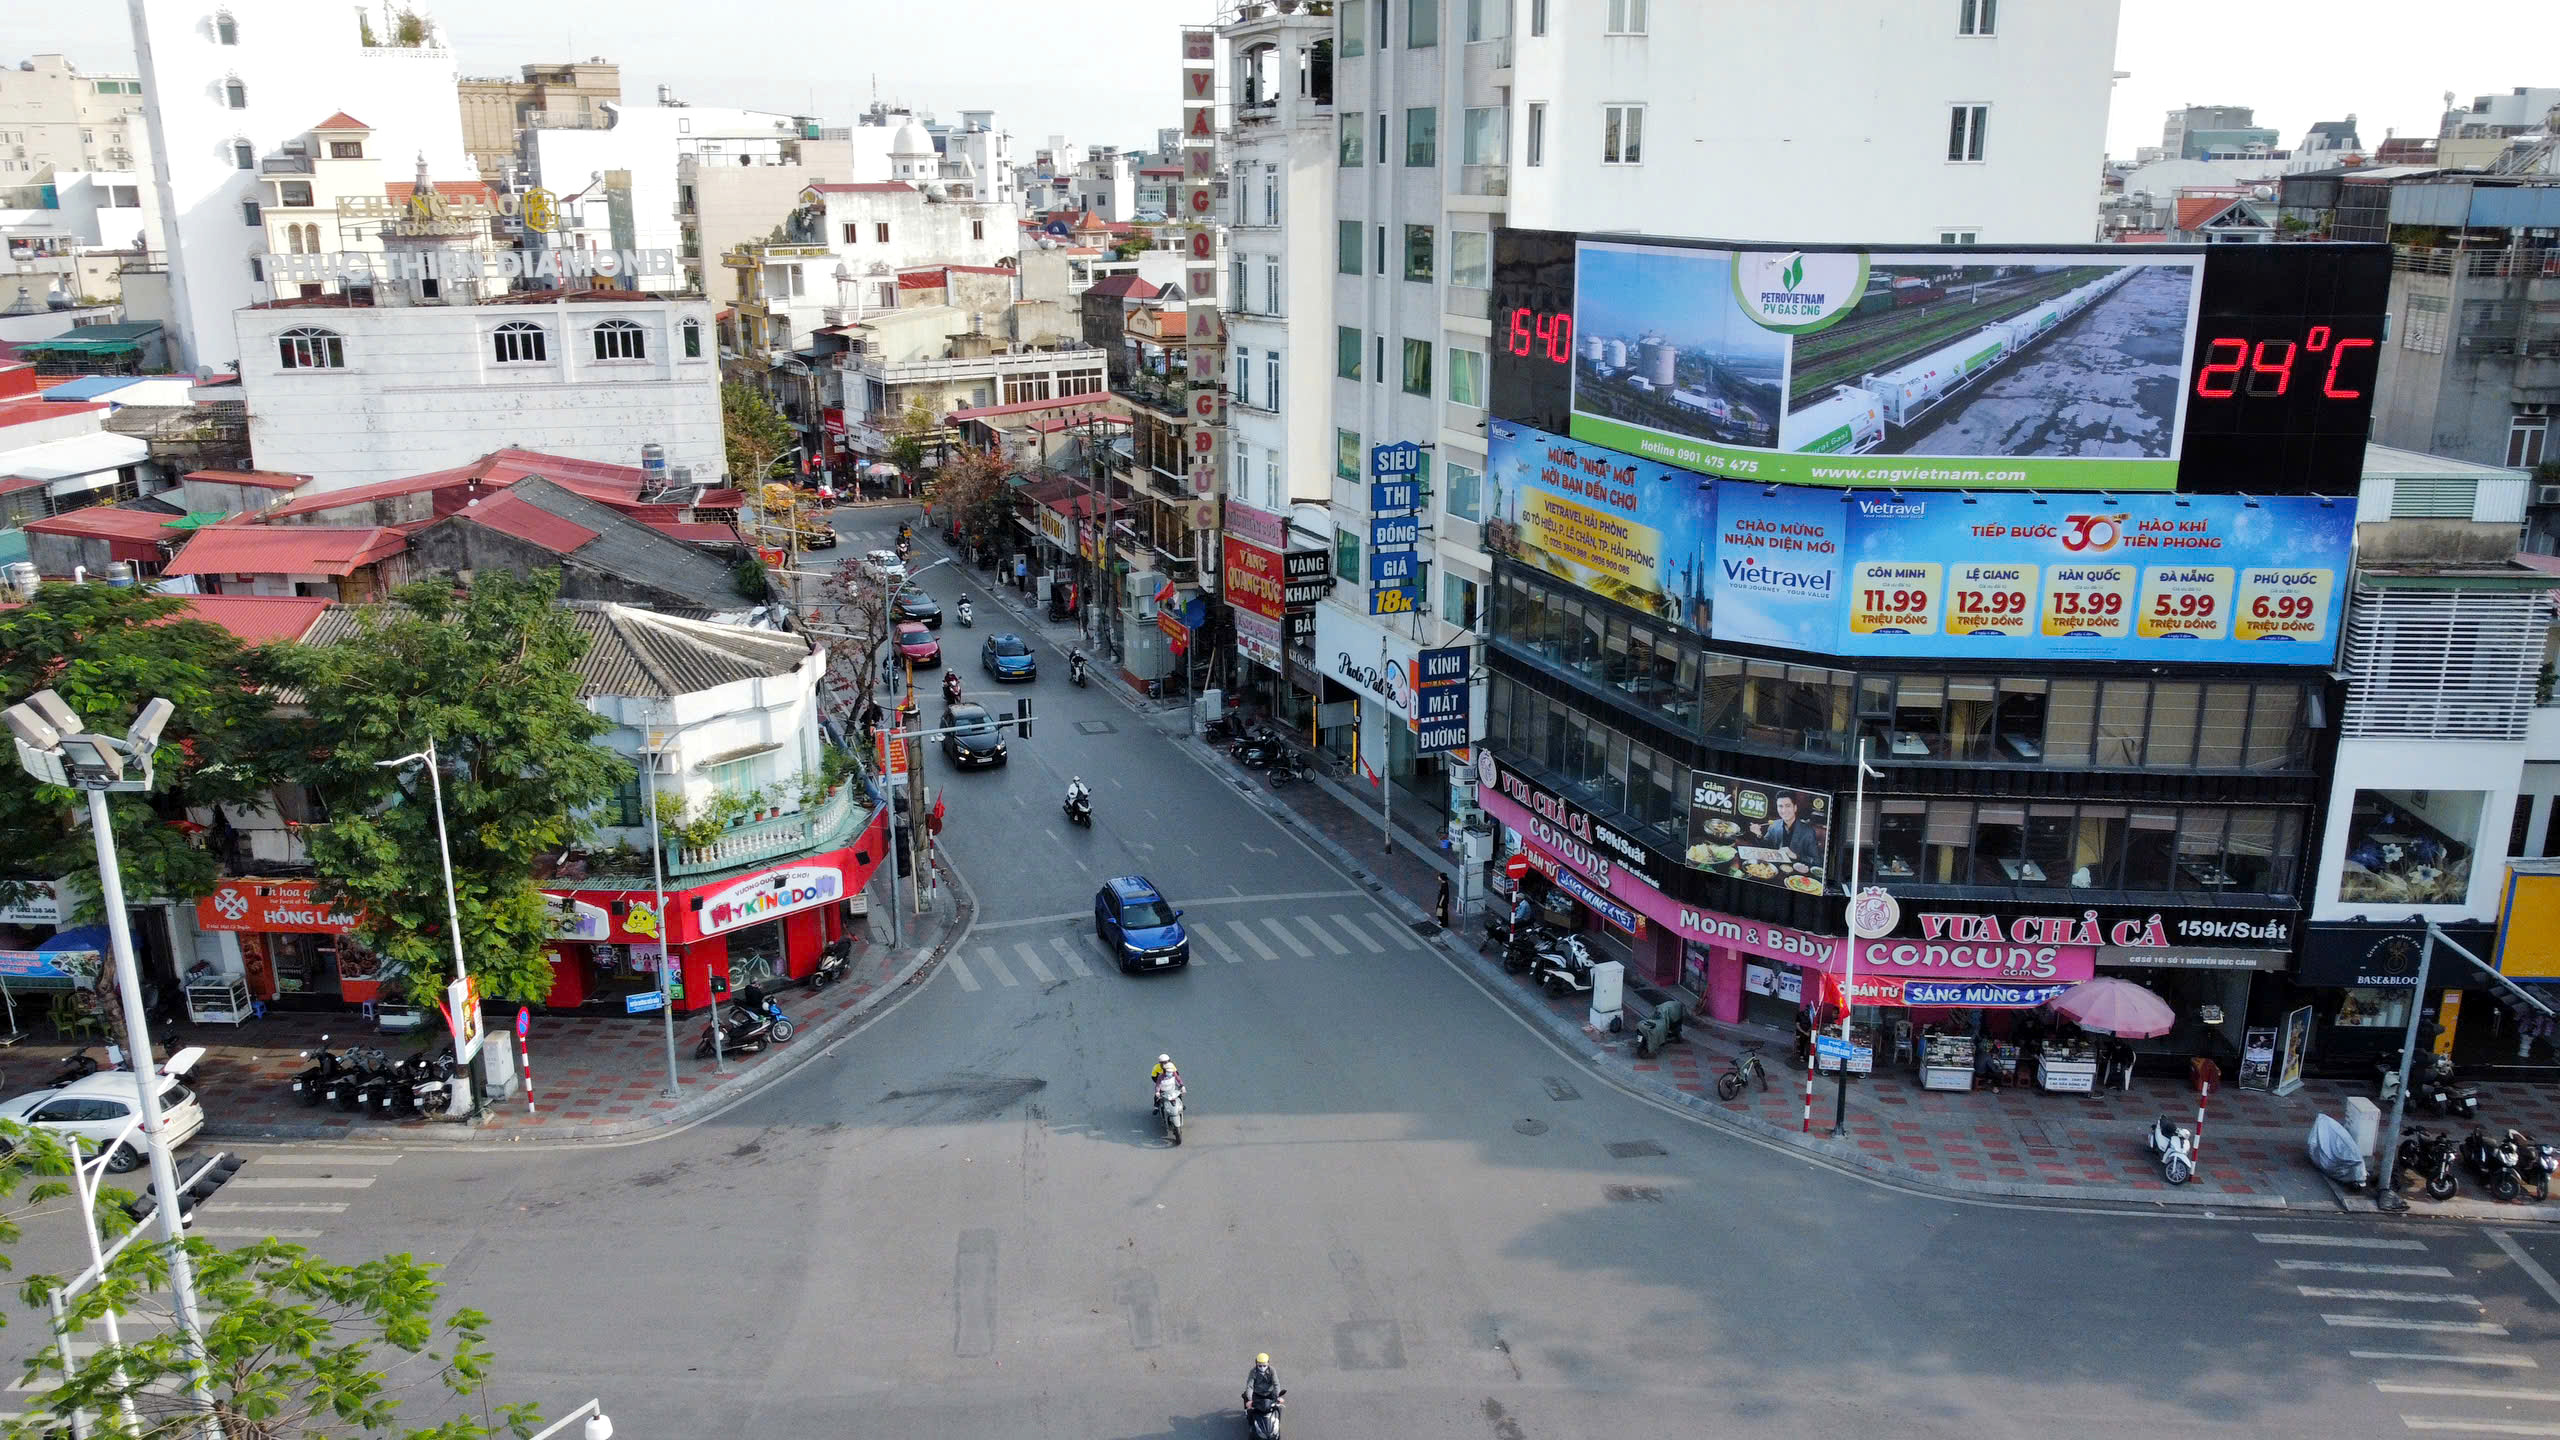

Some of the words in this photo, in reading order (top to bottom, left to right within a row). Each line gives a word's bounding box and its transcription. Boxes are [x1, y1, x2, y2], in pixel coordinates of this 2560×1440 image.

[496, 249, 673, 277] DIAMOND
[1761, 292, 1825, 304] PETROVIETNAM
[1763, 304, 1776, 314] PV
[1778, 305, 1798, 315] GAS
[1801, 305, 1820, 315] CNG
[1378, 447, 1417, 471] SIÊU
[1641, 439, 1675, 457] Hotline
[1678, 449, 1701, 463] 0901
[1704, 453, 1724, 468] 475
[1729, 460, 1759, 474] 475
[1811, 467, 2027, 482] www.cngvietnam.com
[1383, 486, 1411, 509] THỊ
[1562, 474, 1583, 496] BẠN
[1609, 490, 1638, 513] CHƠI
[1859, 498, 1925, 515] Vietravel
[1544, 500, 1582, 524] VIETRAVEL
[1599, 521, 1628, 539] PHÒNG
[1736, 519, 1777, 533] CHÀO
[1781, 522, 1825, 538] MỪNG
[1971, 522, 2007, 538] TIẾP
[2011, 522, 2057, 539] BƯỚC
[2138, 517, 2174, 532] HÀO
[2178, 518, 2209, 532] KHÍ
[1376, 521, 1416, 544] ĐỒNG
[1724, 532, 1765, 549] NHẬN
[1769, 536, 1803, 552] DIỆN
[1807, 540, 1836, 554] MỚI
[2062, 515, 2119, 551] 30
[2123, 534, 2160, 548] TIÊN
[2163, 536, 2222, 549] PHONG
[1289, 556, 1325, 574] VÀNG
[1383, 556, 1408, 577] GIÁ
[1625, 548, 1655, 569] PHÒNG
[1722, 557, 1832, 592] Vietravel
[1867, 566, 1892, 578] CÔN
[1895, 568, 1926, 579] MINH
[1966, 568, 1980, 582] LỆ
[1983, 570, 2020, 580] GIANG
[2058, 569, 2084, 581] HÀN
[2087, 568, 2121, 582] QUỐC
[2159, 570, 2177, 582] ĐÀ
[2180, 569, 2215, 583] NẴNG
[2253, 572, 2279, 584] PHÚ
[2282, 572, 2318, 586] QUỐC
[1285, 585, 1330, 603] KHANG
[1808, 591, 1831, 599] VALUE
[1864, 589, 1927, 613] 11.99
[1957, 591, 2027, 614] 12.99
[2053, 592, 2123, 615] 13.99
[2153, 594, 2216, 617] 5.99
[2252, 595, 2314, 619] 6.99
[1339, 652, 1364, 683] Photo
[1428, 654, 1460, 676] KÍNH
[1429, 688, 1458, 713] MẮT
[1421, 726, 1466, 749] ĐƯỜNG
[1501, 770, 1532, 808] VUA
[1533, 791, 1568, 830] CHẢ
[1694, 788, 1733, 809] 50%
[1530, 817, 1611, 889] concung
[253, 886, 277, 897] Tih
[279, 886, 300, 897] hoa
[263, 905, 315, 925] HỒNG
[1680, 909, 1741, 941] Mom
[1745, 928, 1760, 946] &
[1767, 929, 1834, 964] Baby
[1918, 913, 2006, 944] VUA
[2010, 910, 2106, 946] CHẢ
[2111, 914, 2170, 948] CÁ
[2177, 918, 2288, 940] 159k/Suất
[1866, 943, 2057, 978] concung
[2356, 975, 2418, 985] BASE&BLOO
[1851, 983, 1878, 997] BÁN
[1881, 986, 1899, 998] TỪ
[1913, 985, 1962, 1002] SÁNG
[1965, 985, 2019, 1002] MÙNG
[2024, 986, 2035, 1002] 4
[2041, 984, 2070, 1000] TẾ
